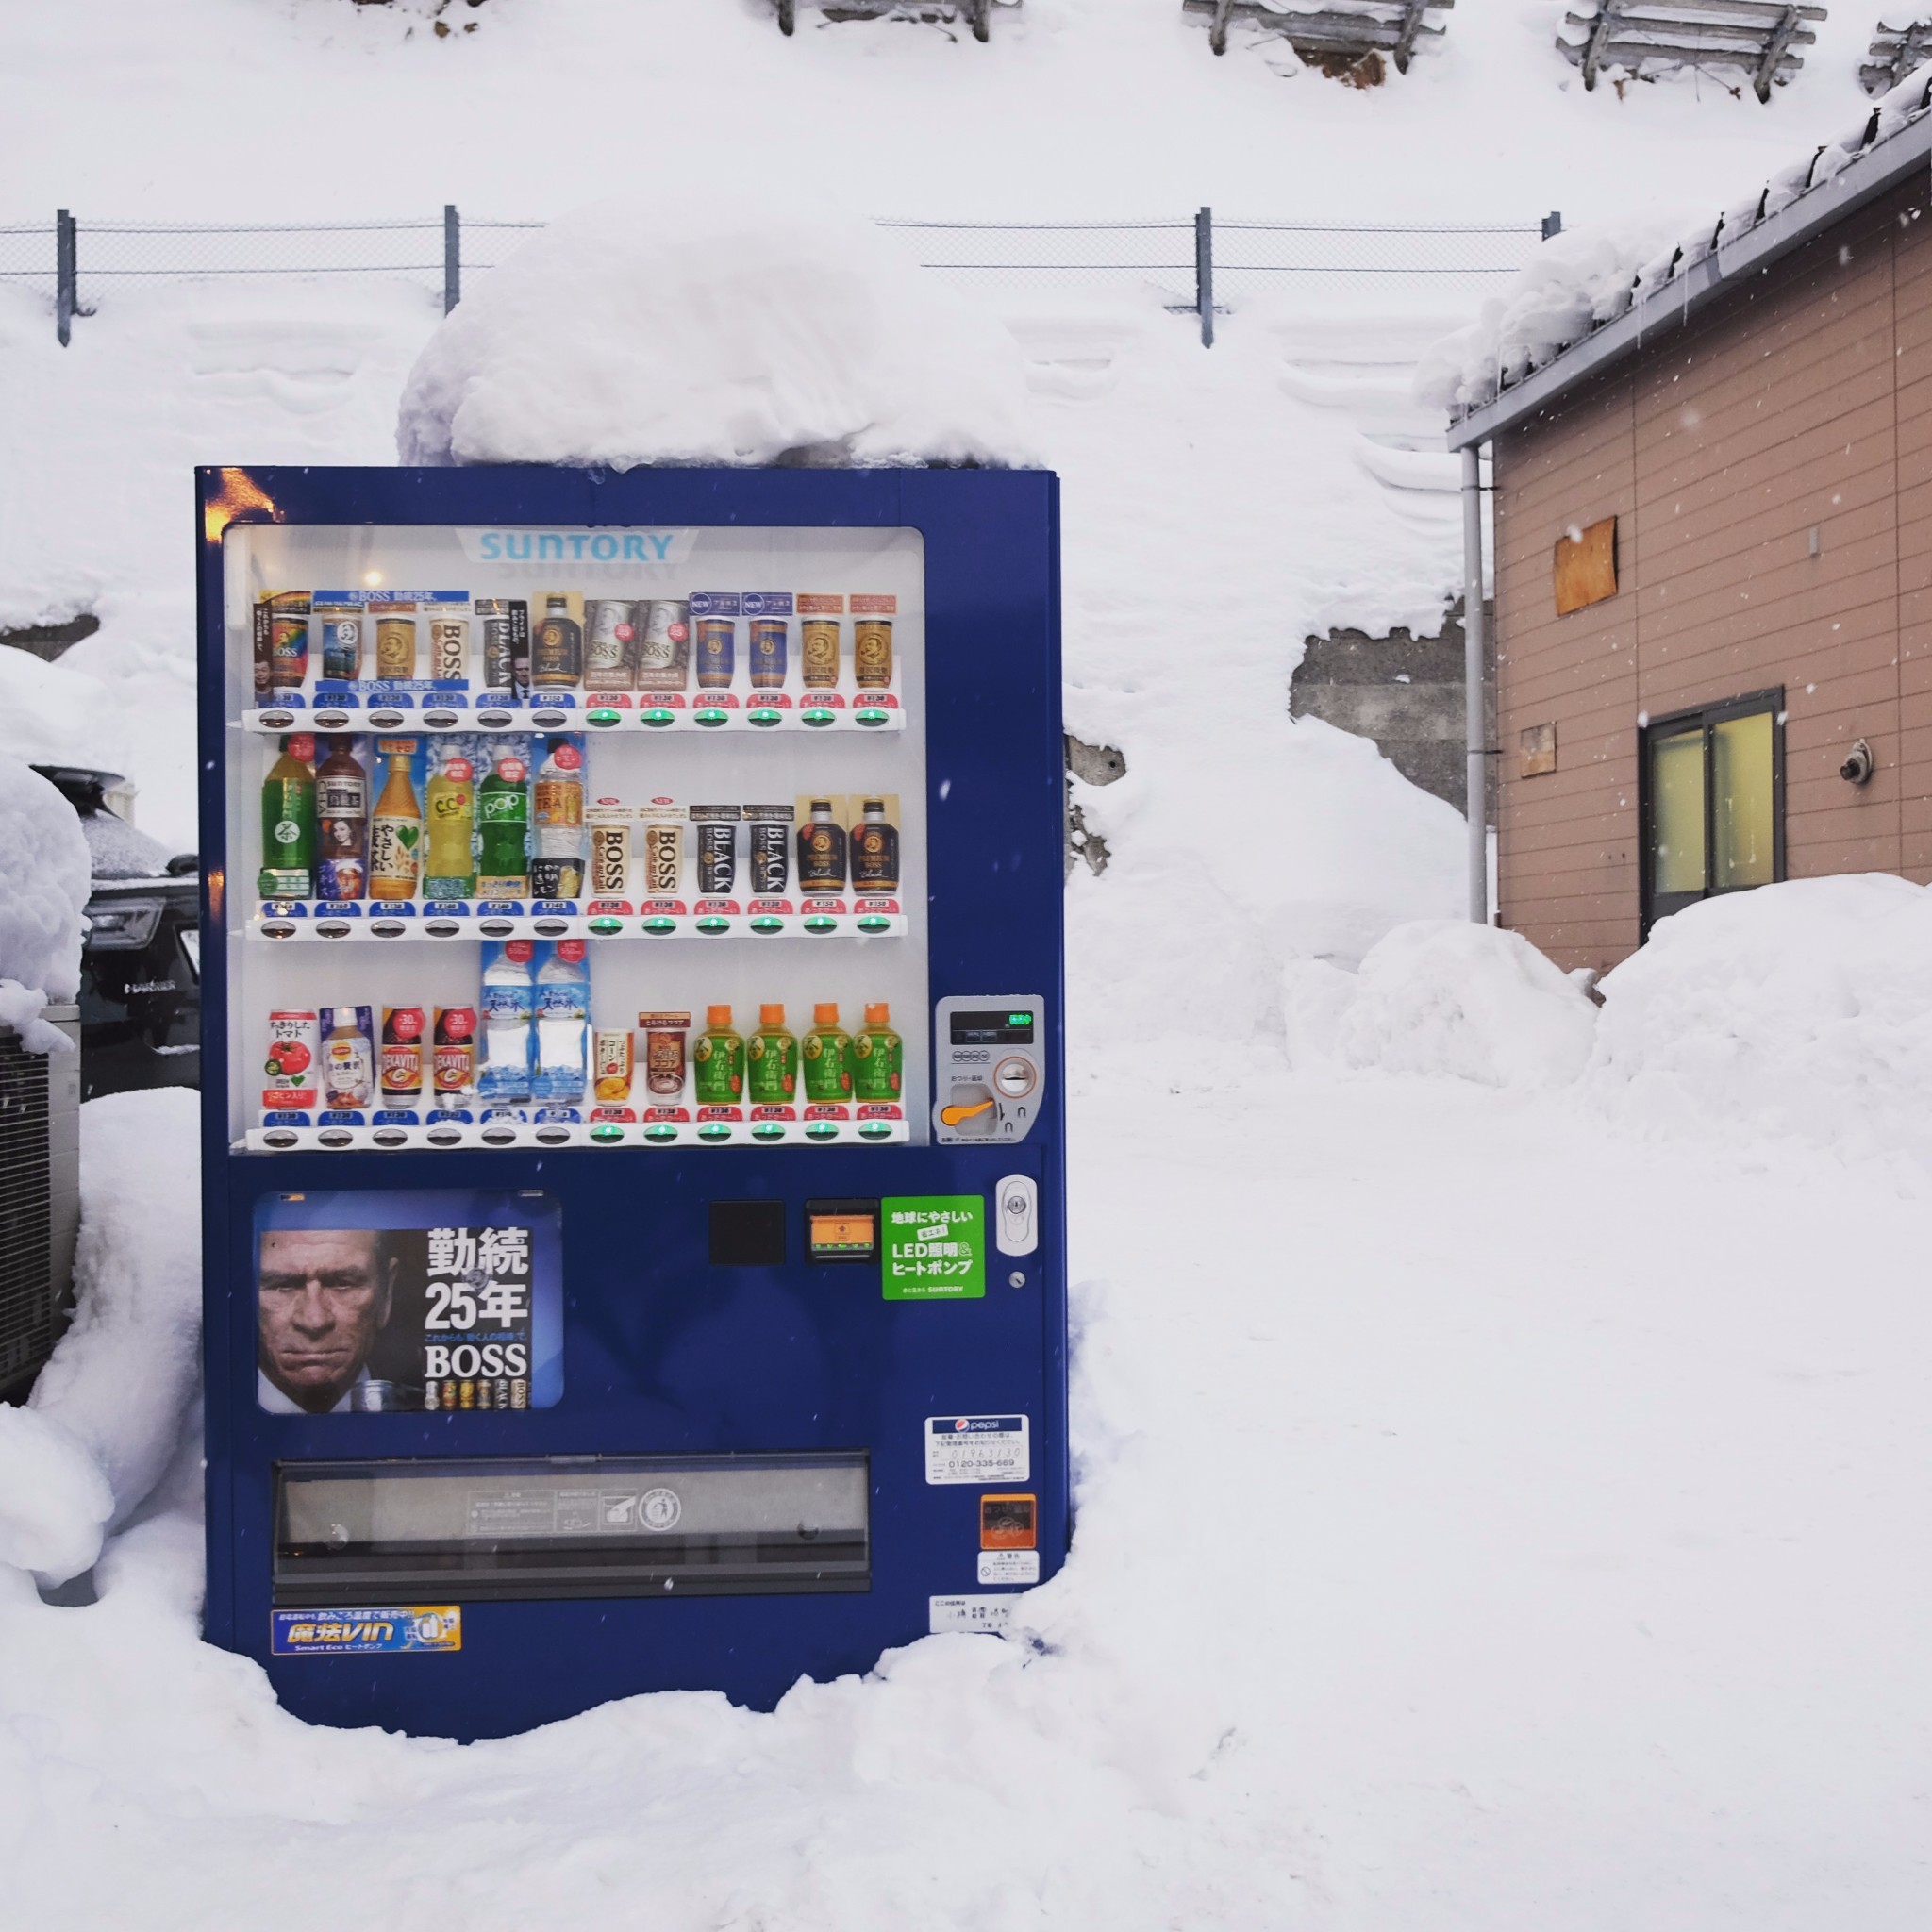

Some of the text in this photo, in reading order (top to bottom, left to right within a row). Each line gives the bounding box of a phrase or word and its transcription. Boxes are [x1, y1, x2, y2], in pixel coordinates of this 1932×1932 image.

[480, 533, 674, 561] SUNTORY
[443, 624, 461, 680] BOSS
[536, 797, 564, 810] TEA
[606, 831, 624, 889] BOSS
[658, 830, 676, 889] BOSS
[714, 827, 733, 890] BLACK
[767, 827, 785, 890] BLACK
[489, 999, 525, 1012] 天然水
[542, 997, 578, 1010] 天然水
[276, 1029, 302, 1038] トマト
[891, 1210, 974, 1224] 地球にやさしい
[427, 1226, 529, 1277] 勤続
[892, 1259, 974, 1276] ヒートポンプ
[425, 1279, 528, 1330] 25年
[424, 1343, 527, 1378] BOSS
[970, 1420, 1000, 1430] pepsi
